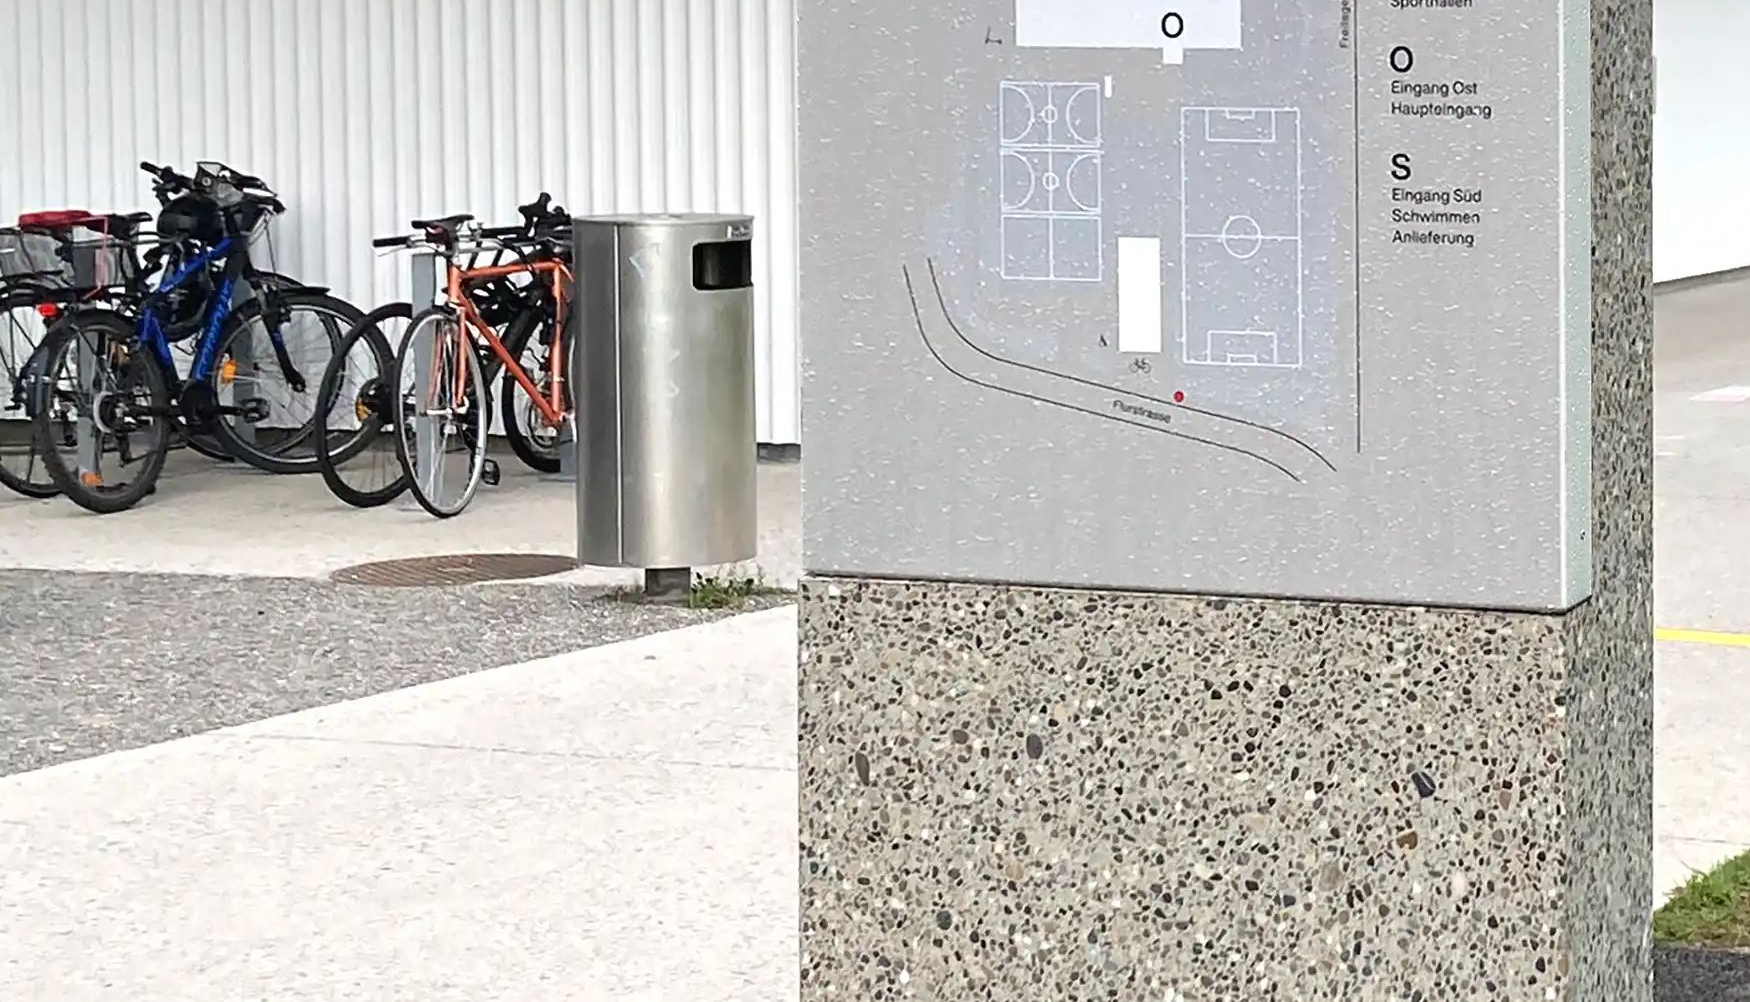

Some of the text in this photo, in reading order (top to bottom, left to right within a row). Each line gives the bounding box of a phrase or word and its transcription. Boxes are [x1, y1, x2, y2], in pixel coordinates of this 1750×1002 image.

[1161, 11, 1184, 39] O
[1389, 45, 1414, 73] O
[1391, 80, 1478, 98] Eingang Ost
[1391, 102, 1492, 120] Haupteingang
[1391, 153, 1411, 181] S
[1391, 187, 1482, 206] Eingang Süd
[1391, 208, 1481, 224] Schwimmen
[1391, 229, 1475, 248] Anlieferung
